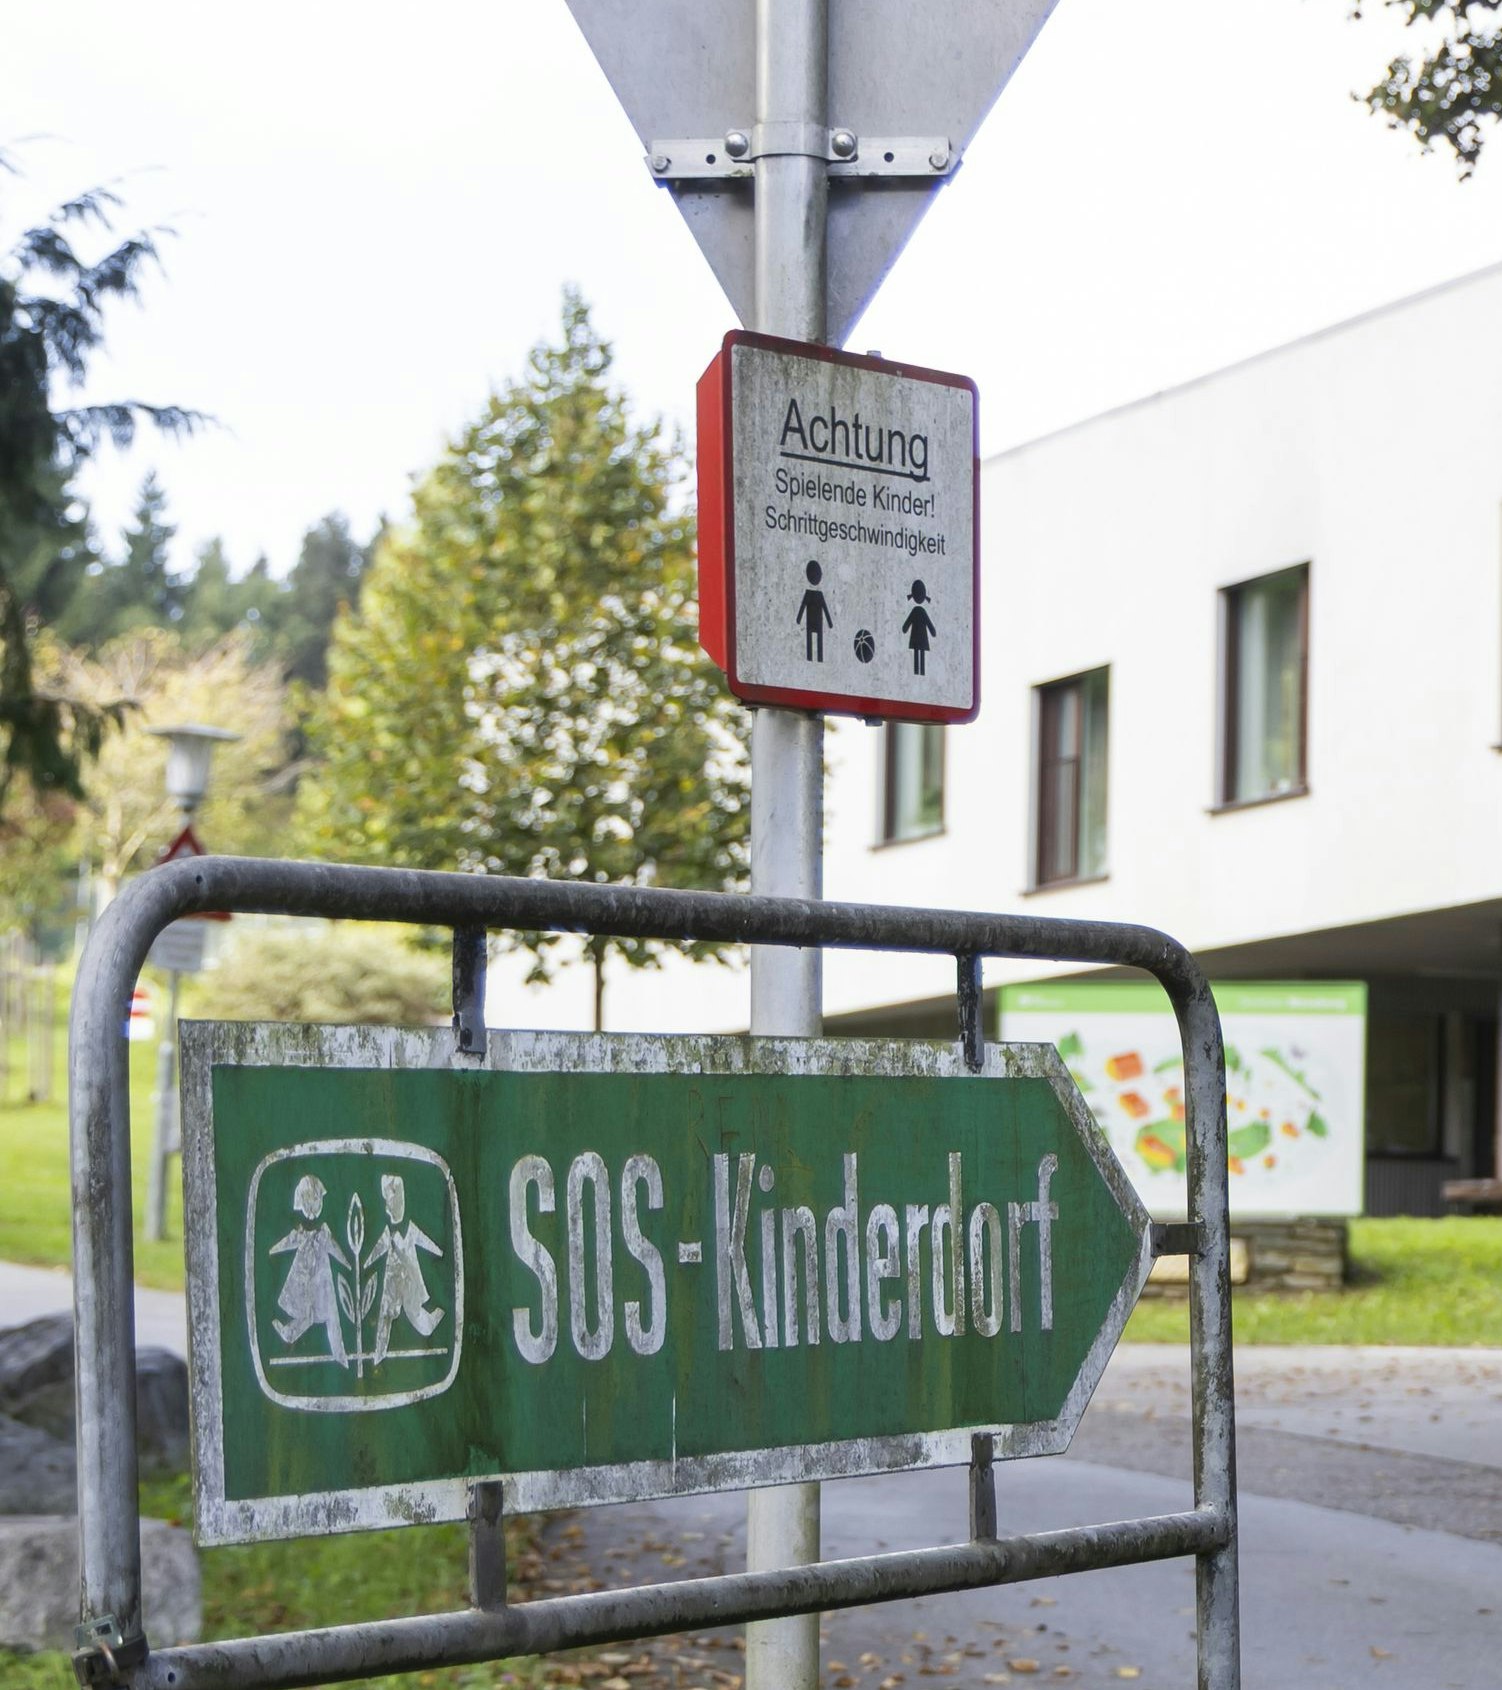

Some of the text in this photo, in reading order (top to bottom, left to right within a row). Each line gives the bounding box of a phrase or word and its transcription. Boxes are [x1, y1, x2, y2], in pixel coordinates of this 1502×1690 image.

[780, 398, 929, 482] Achtung
[775, 468, 935, 518] Spielende Kinder!
[765, 506, 946, 556] Schrittgeschwindigkeit
[509, 1151, 1059, 1364] SOS-Kinderdorf
